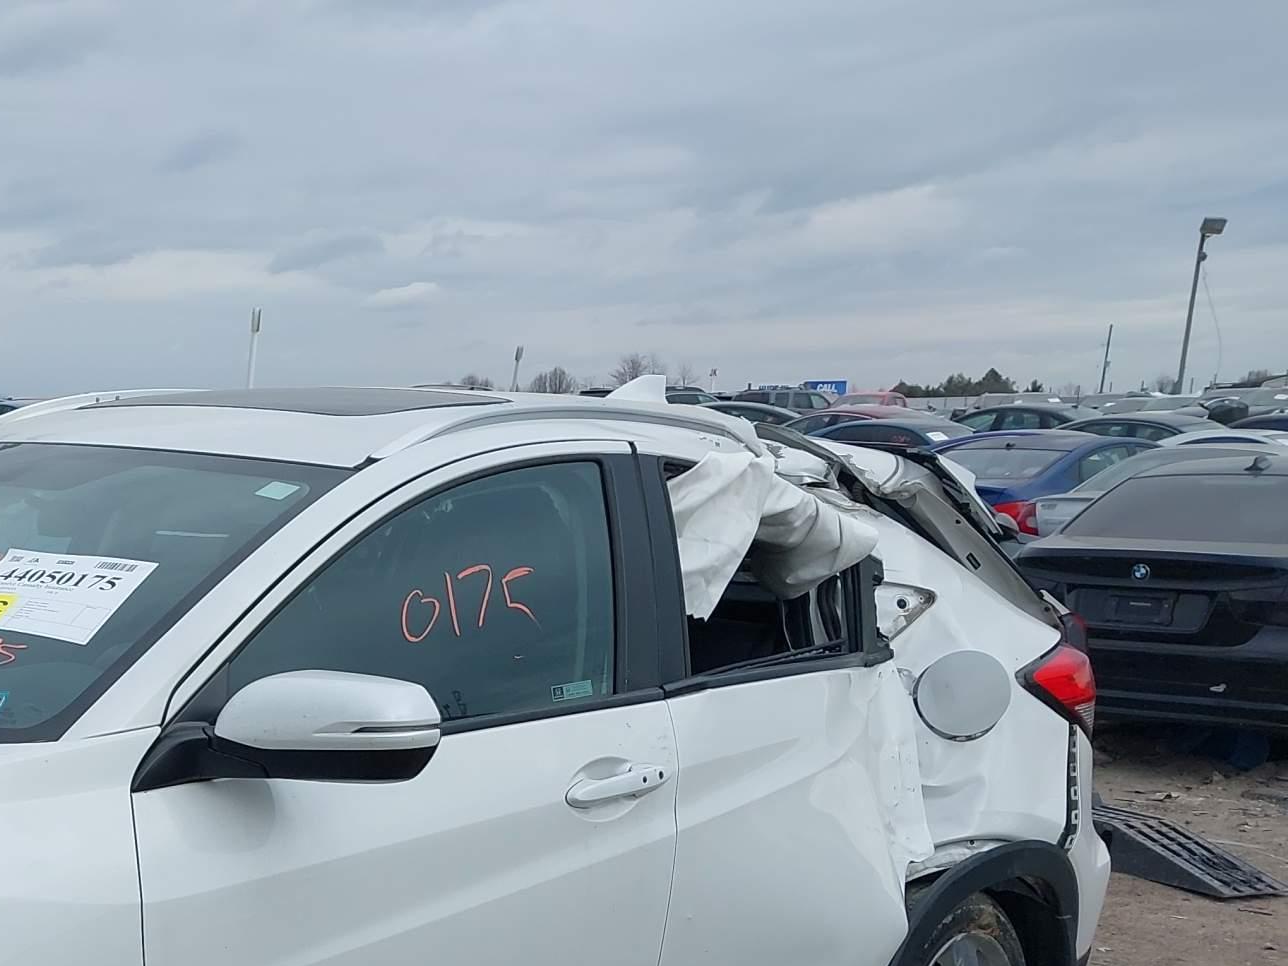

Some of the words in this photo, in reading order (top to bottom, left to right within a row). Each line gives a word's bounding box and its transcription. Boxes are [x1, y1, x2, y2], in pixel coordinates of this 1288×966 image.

[816, 384, 837, 393] CALL
[0, 567, 123, 591] 44050175
[401, 563, 542, 643] 0175
